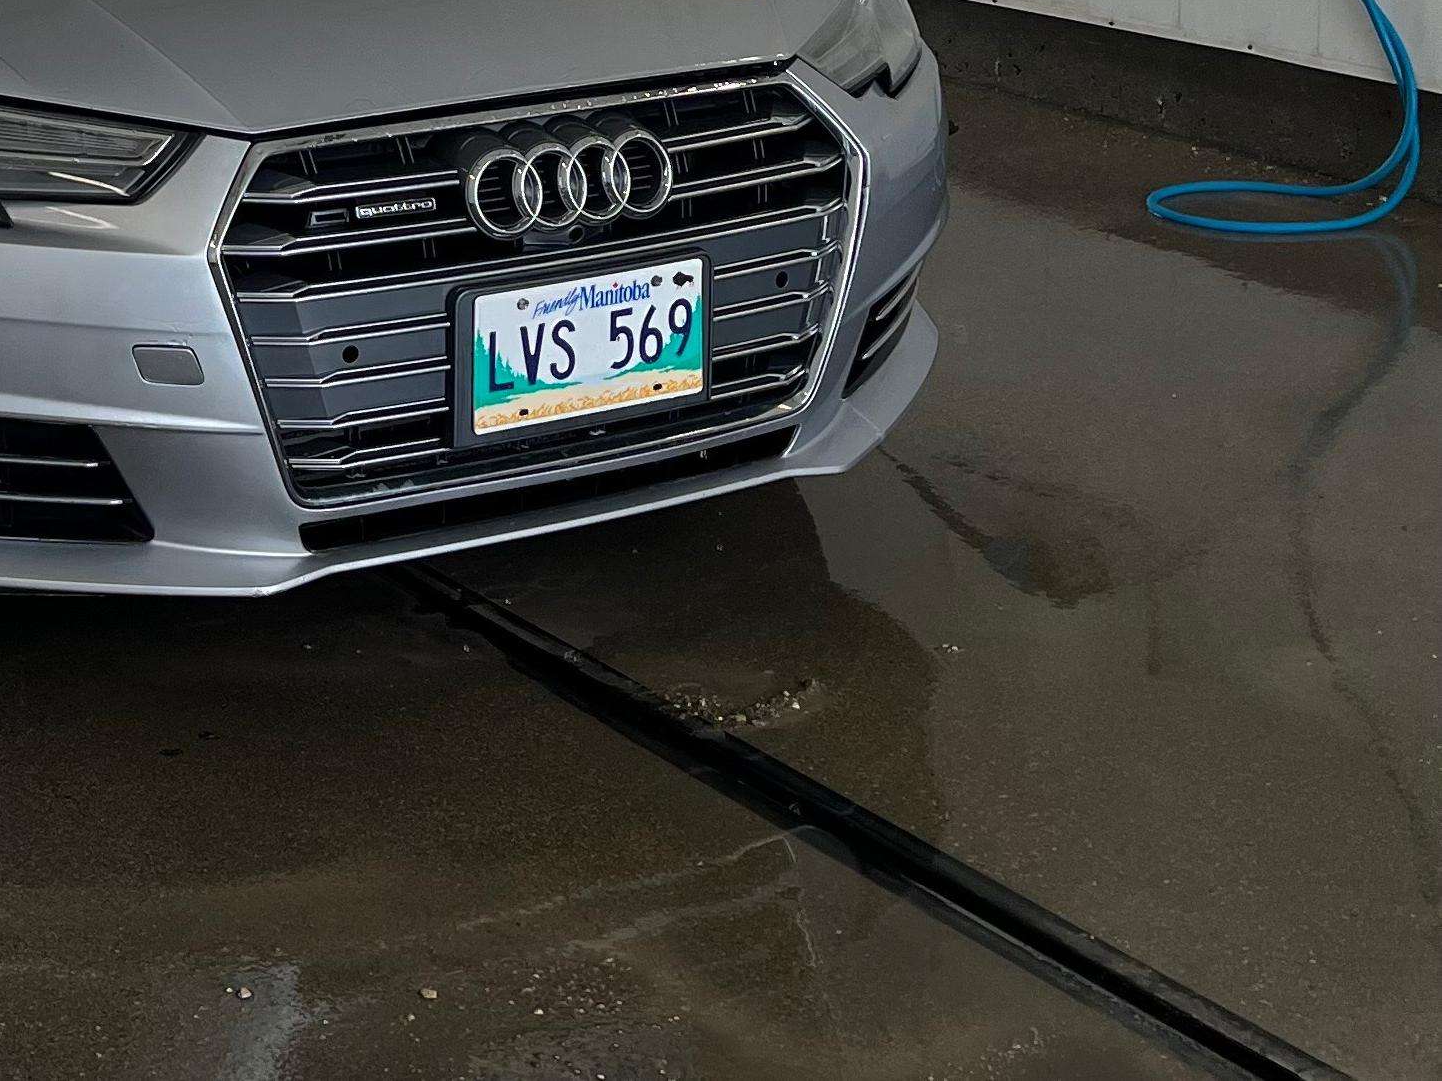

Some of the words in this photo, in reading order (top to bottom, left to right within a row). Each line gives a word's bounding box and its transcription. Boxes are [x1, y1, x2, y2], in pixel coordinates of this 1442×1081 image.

[358, 199, 433, 217] quattro
[532, 286, 582, 320] Friendly
[578, 280, 651, 311] Manitoba
[489, 319, 576, 393] LVS
[609, 298, 693, 369] 569
